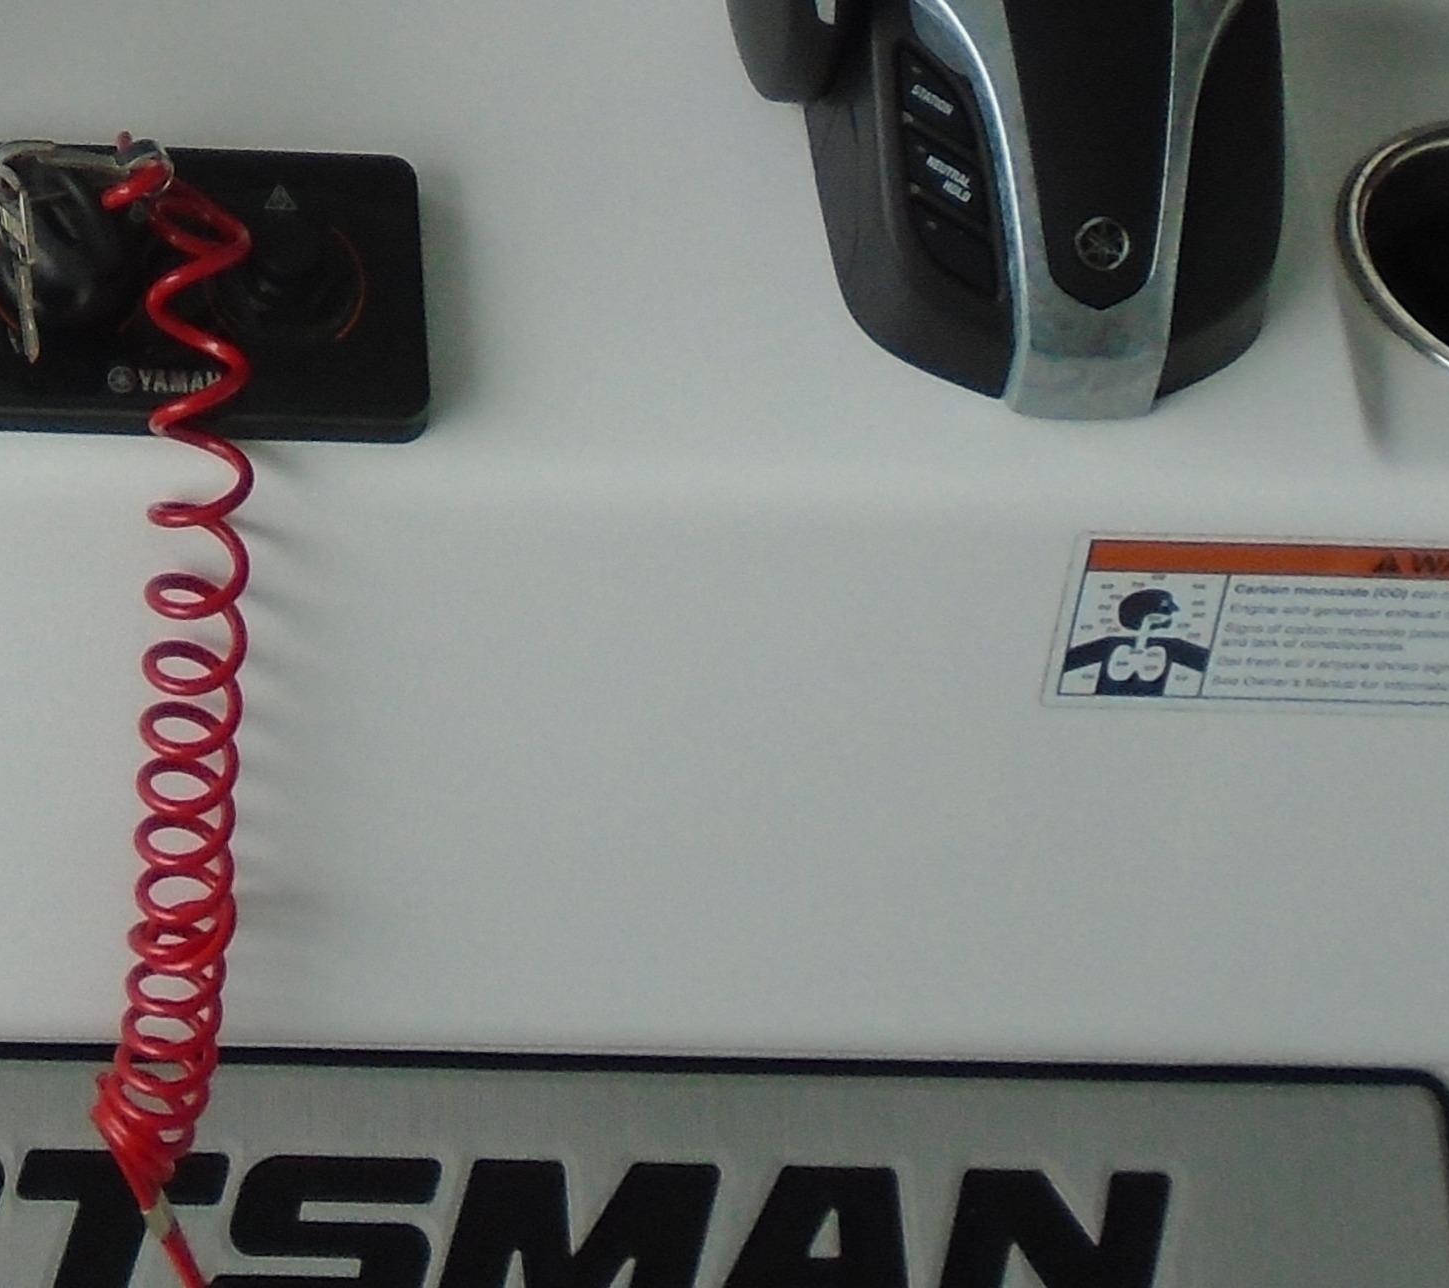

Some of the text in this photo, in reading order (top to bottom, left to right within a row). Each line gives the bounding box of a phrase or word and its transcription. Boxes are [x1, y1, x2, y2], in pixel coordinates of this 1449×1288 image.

[910, 84, 954, 116] STATION
[926, 155, 971, 188] NEUTRAL
[943, 180, 972, 203] HOLD
[138, 369, 222, 393] YAMAH
[1234, 583, 1290, 595] Carbon
